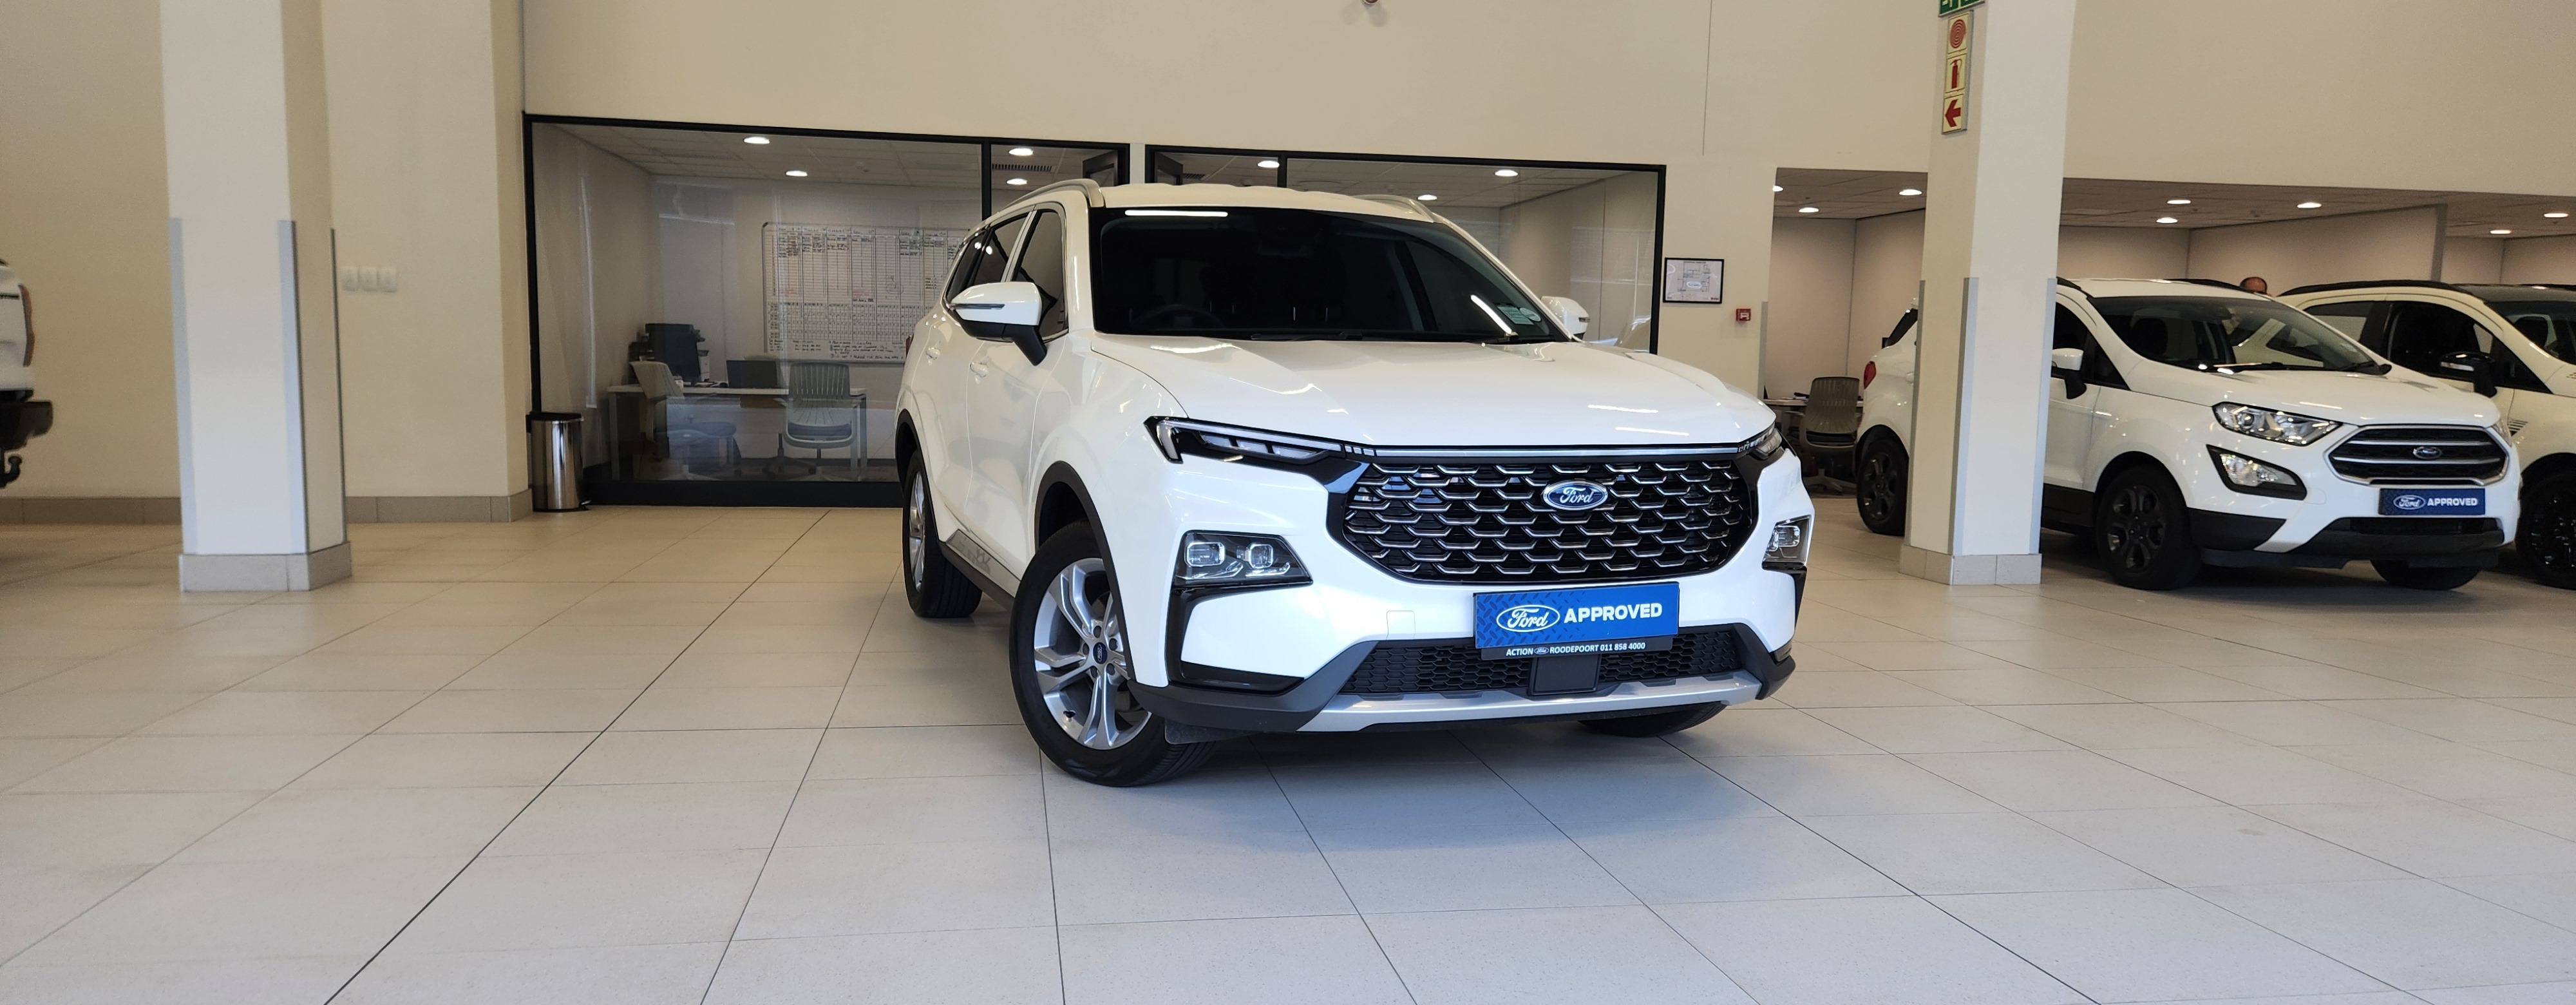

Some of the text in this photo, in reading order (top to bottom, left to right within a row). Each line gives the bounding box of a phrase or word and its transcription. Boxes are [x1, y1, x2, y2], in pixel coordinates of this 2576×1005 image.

[1560, 487, 1594, 503] Ford
[2398, 497, 2478, 507] Ford APPROVED
[1506, 603, 1663, 629] Ford APPROVED
[1506, 647, 1533, 656] ACTION
[1549, 644, 1599, 654] ROODEPOORT
